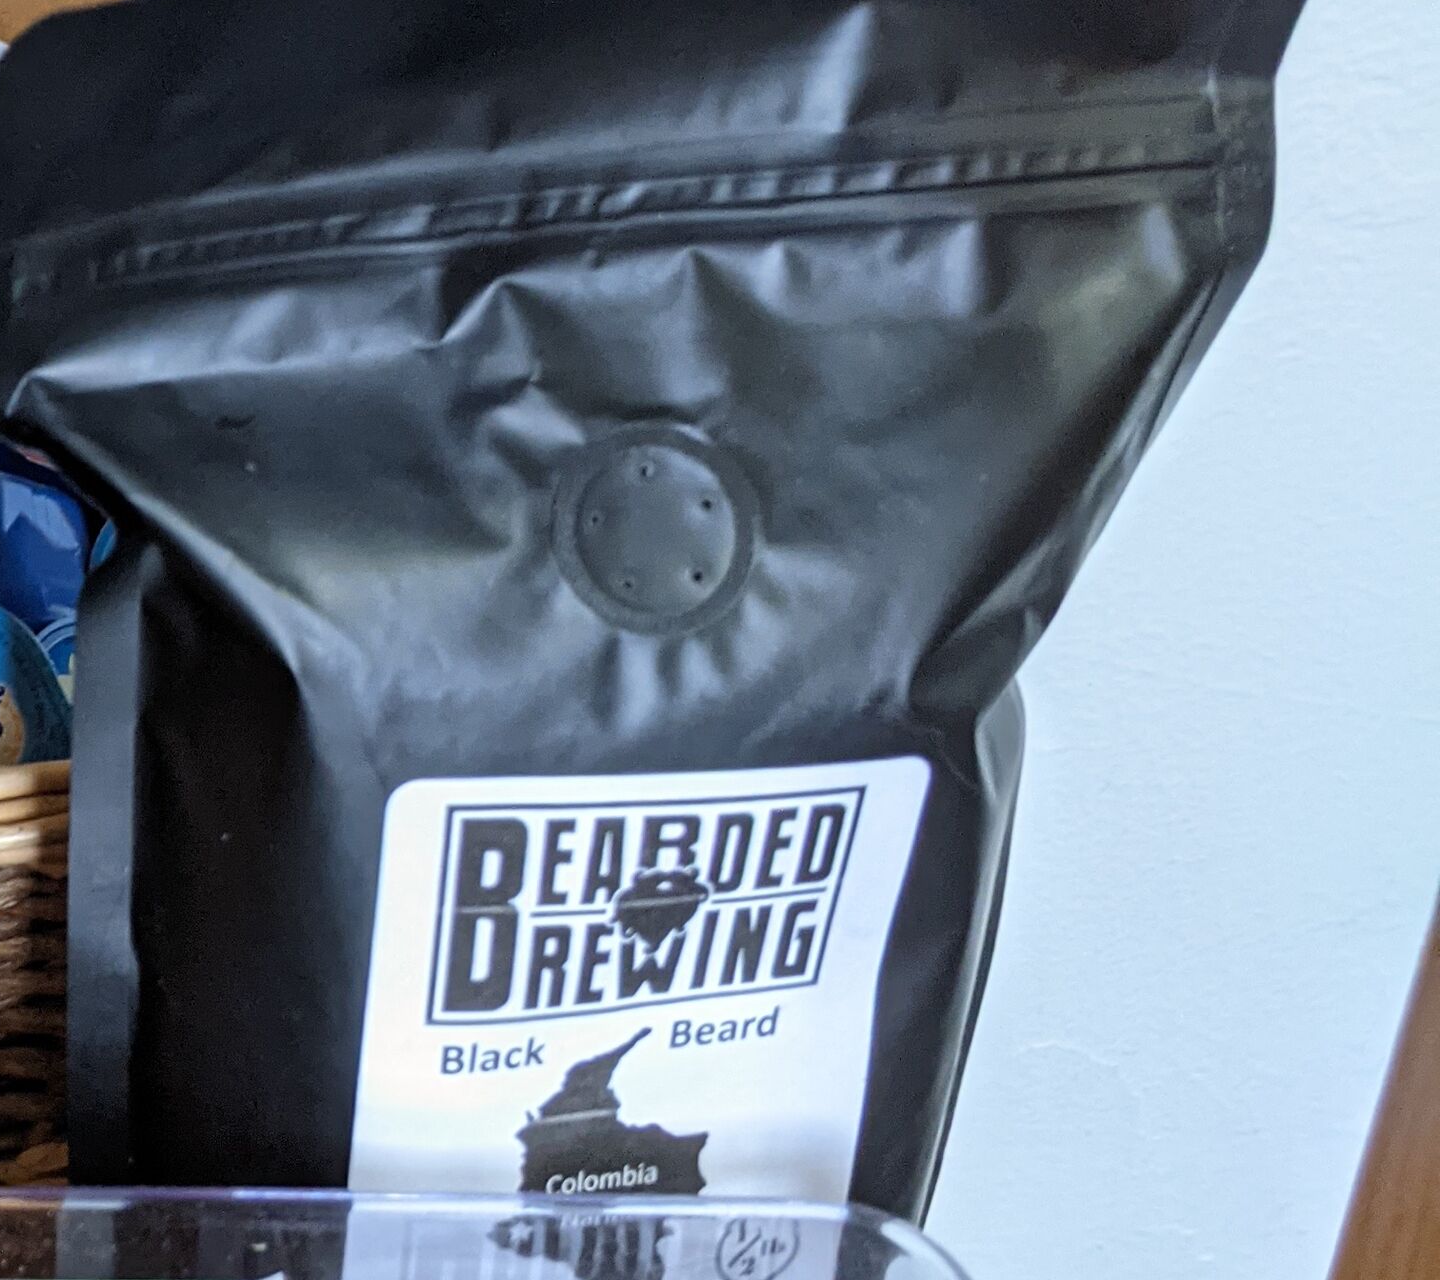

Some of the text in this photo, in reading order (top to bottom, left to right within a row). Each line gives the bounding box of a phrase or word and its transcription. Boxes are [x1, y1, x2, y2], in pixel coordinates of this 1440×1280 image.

[456, 804, 847, 910] BEARDED
[440, 900, 820, 1012] BREWING
[440, 1005, 781, 1075] Black Beard
[545, 1162, 659, 1195] Colombia
